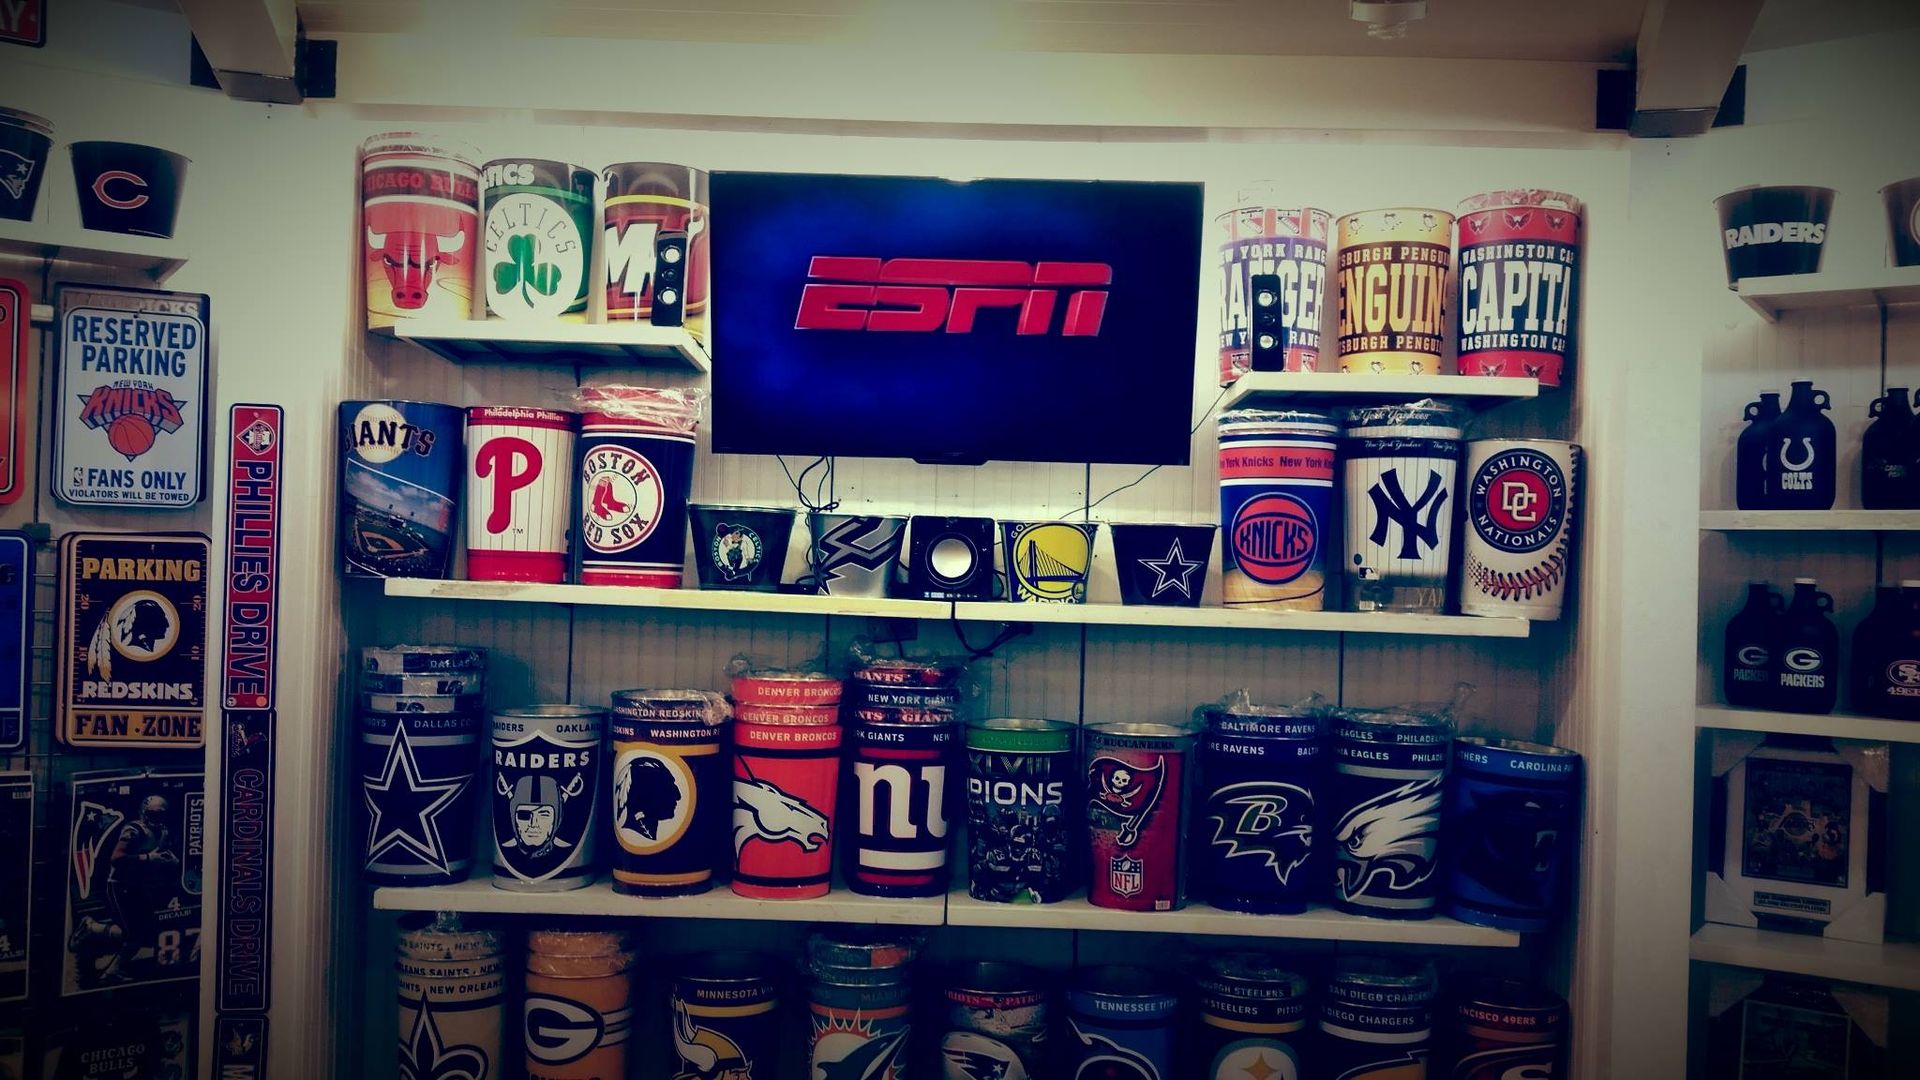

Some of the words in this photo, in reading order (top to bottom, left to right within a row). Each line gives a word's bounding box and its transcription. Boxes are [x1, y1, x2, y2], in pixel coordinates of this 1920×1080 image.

[486, 203, 577, 253] CELTICS
[1725, 222, 1826, 249] RAIDERS
[1240, 244, 1286, 259] YORK
[1463, 244, 1555, 264] WASHINGTON
[794, 255, 1112, 336] ESPN
[1463, 260, 1571, 336] CAPITA
[73, 315, 197, 350] RESERVED
[82, 345, 186, 377] PARKING
[79, 385, 184, 434] KNICKS
[484, 408, 534, 419] Philadelphia
[1242, 456, 1274, 467] Knicks
[1280, 455, 1303, 467] New
[88, 468, 134, 488] FANS
[142, 471, 186, 490] ONLY
[475, 437, 543, 533] P
[1477, 455, 1562, 498] WASHINGTON
[1781, 472, 1813, 490] COLTS
[69, 488, 119, 499] VIOLATORS
[122, 490, 143, 500] WILL
[145, 491, 156, 501] BE
[159, 491, 189, 501] TOWED
[231, 460, 274, 593] PHILLIES
[611, 513, 649, 544] SOX
[1479, 515, 1558, 546] NATIONALS
[1239, 521, 1308, 558] KNICKS
[82, 558, 200, 582] PARKING
[228, 602, 269, 696] DRIVE
[1780, 672, 1824, 688] PACKERS
[82, 680, 193, 700] REDSKINS
[758, 687, 800, 697] DENVER
[868, 694, 888, 703] NEW
[892, 695, 920, 705] YORK
[76, 715, 129, 736] FAN
[142, 716, 201, 736] ZONE
[414, 719, 457, 729] DALLAS
[650, 728, 712, 738] WASHINGTON
[1221, 721, 1281, 733] BALTIMORE
[750, 731, 790, 741] DENVER
[795, 732, 837, 741] BRONCOS
[867, 731, 904, 742] GIANTS
[1223, 744, 1264, 755] RAVENS
[1351, 749, 1390, 760] EAGLES
[495, 750, 590, 769] RAIDERS
[1510, 760, 1562, 772] CAROLINA
[189, 799, 204, 855] PATRIOTS
[228, 769, 265, 914] CARDINALS
[1114, 874, 1138, 890] NFL
[228, 918, 263, 997] DRIVE
[429, 968, 469, 976] SAINTS
[430, 986, 455, 994] NEW
[697, 988, 759, 1000] MINNESOTA
[1350, 990, 1383, 1002] DIEGO
[1095, 1000, 1157, 1012] TENNESSEE
[1210, 999, 1258, 1016] STEELERS
[1327, 1007, 1355, 1021] DIEGO
[1359, 1015, 1414, 1026] CHARGERS
[1502, 1015, 1536, 1025] 49ERS
[81, 1043, 145, 1064] CHICAGO
[90, 1057, 136, 1074] BULLS
